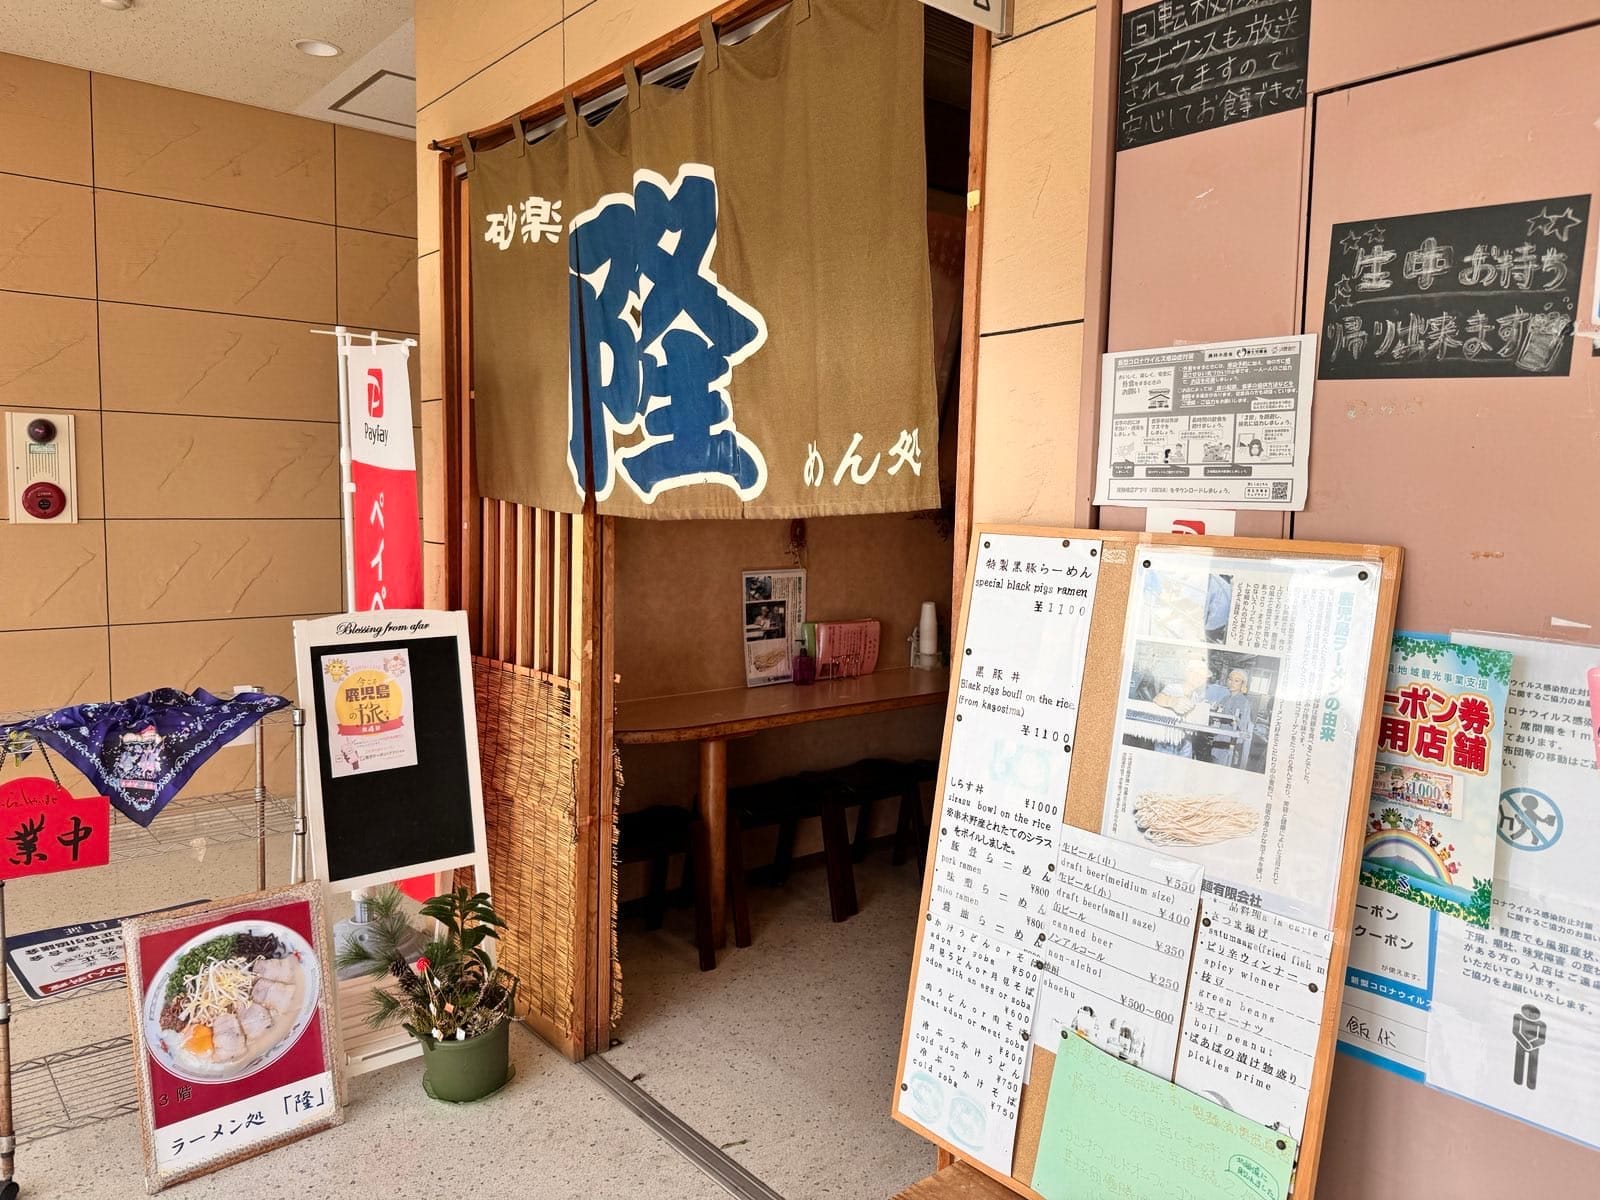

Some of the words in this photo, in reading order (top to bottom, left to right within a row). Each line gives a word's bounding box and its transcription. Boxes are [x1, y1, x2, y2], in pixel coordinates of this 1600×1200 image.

[1124, 7, 1299, 79] アナウンスも放送
[1125, 47, 1296, 114] されてますので
[484, 196, 562, 250] 砂楽
[567, 162, 768, 504] 隆
[1327, 305, 1531, 362] 帰り出来ます
[803, 428, 922, 487] めん処
[985, 558, 1093, 580] 特製黒豚らーめん
[975, 578, 1004, 589] special
[1007, 579, 1031, 592] black
[1033, 583, 1053, 595] pigs
[1056, 586, 1088, 598] ramen
[336, 622, 384, 638] Blessing
[384, 620, 408, 637] from
[409, 620, 430, 633] afar
[345, 684, 390, 702] 鹿児島
[960, 678, 981, 692] Black
[983, 685, 1000, 697] pigs
[1025, 692, 1036, 704] on
[1038, 694, 1053, 706] the
[1056, 699, 1076, 711] rice
[1511, 679, 1590, 697] ウイルス感染防止対
[349, 702, 388, 726] の旅
[1504, 706, 1593, 728] ロナウイルス感染
[1020, 724, 1070, 744] ¥1100
[1378, 717, 1487, 772] 用店舗
[977, 800, 997, 815] bowl
[1000, 809, 1010, 819] on
[1014, 812, 1029, 824] the
[1031, 818, 1051, 831] rice
[1025, 798, 1058, 816] ¥1000
[959, 860, 982, 875] ramen
[1030, 883, 1050, 898] ¥800
[1060, 858, 1083, 873] draft
[1151, 890, 1175, 905] size)
[1056, 887, 1079, 903] draft
[1053, 901, 1087, 922] 缶ビール
[1048, 933, 1106, 961] ノンアルコール
[1052, 919, 1086, 940] canned
[1091, 933, 1113, 949] beer
[1354, 924, 1414, 950] クーポン
[957, 943, 967, 953] or
[1011, 965, 1038, 983] ¥500
[1204, 957, 1234, 975] spicy
[1241, 970, 1280, 992] wiener
[1291, 954, 1312, 971] fish
[946, 965, 963, 980] with
[968, 977, 976, 986] an
[980, 983, 995, 995] egg
[1011, 996, 1031, 1011] soba
[1201, 970, 1225, 988] 枝豆
[1004, 1006, 1030, 1024] ¥600
[1198, 989, 1233, 1007] green
[1239, 1001, 1276, 1024] beans
[920, 994, 939, 1008] meat
[943, 1006, 963, 1020] udon
[968, 1018, 976, 1027] or
[980, 1024, 1001, 1039] meat
[1005, 1037, 1025, 1051] soba
[1194, 1018, 1219, 1035] boil
[915, 1032, 934, 1046] cold
[939, 1044, 960, 1060] udon
[996, 1075, 1018, 1093] ¥750
[999, 1046, 1022, 1065] ¥800
[1187, 1049, 1230, 1073] pickles
[1236, 1071, 1272, 1092] prime
[1189, 1032, 1298, 1086] ばあばの漬け物盛り
[912, 1058, 933, 1073] cold
[938, 1072, 958, 1088] soba
[158, 1085, 192, 1107] 3階
[991, 1101, 1014, 1120] ¥750
